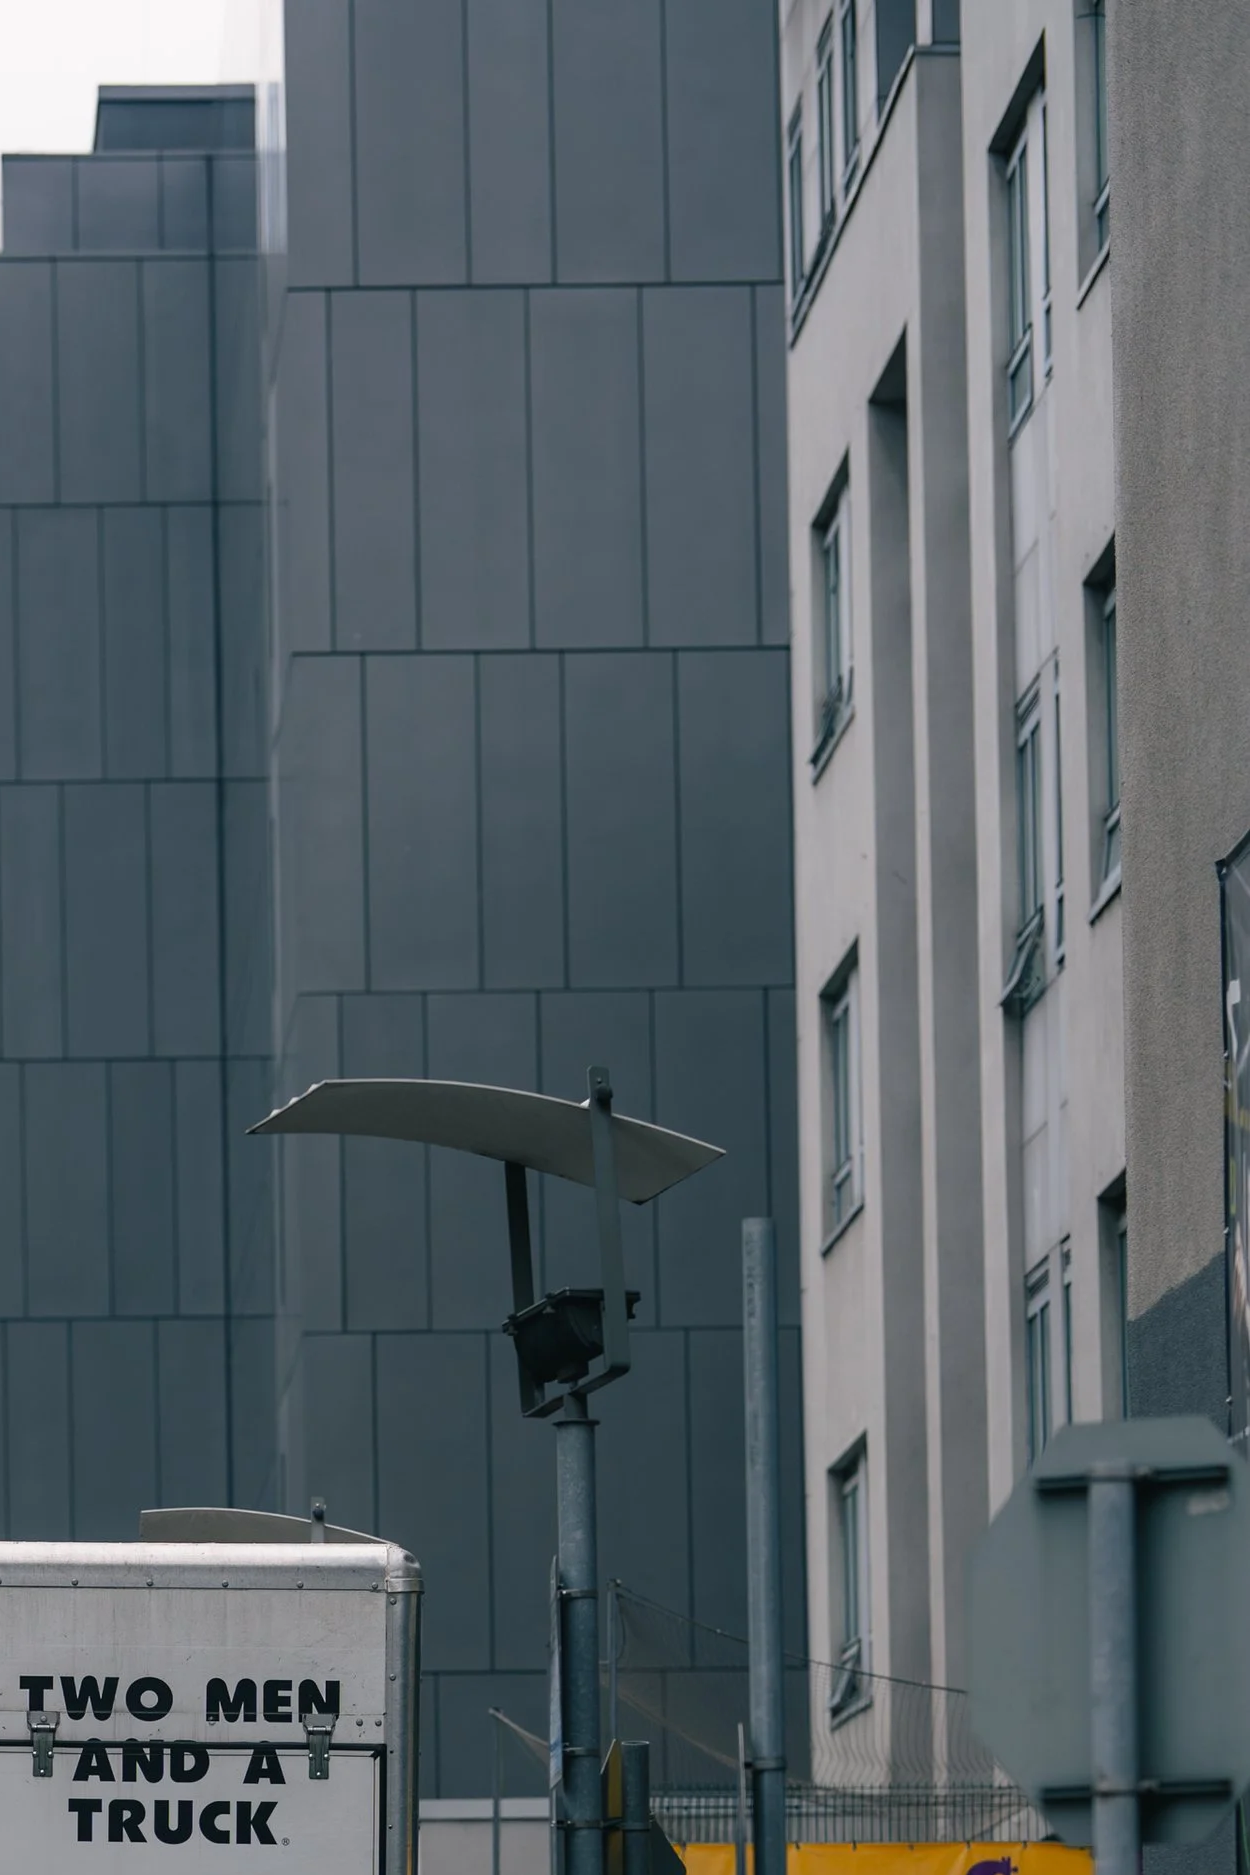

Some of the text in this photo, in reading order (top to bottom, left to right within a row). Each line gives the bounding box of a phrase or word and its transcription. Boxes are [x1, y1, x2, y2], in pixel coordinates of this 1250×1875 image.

[20, 1675, 341, 1723] TWO MEN
[73, 1739, 286, 1784] AND A
[68, 1798, 278, 1844] TRUCK
